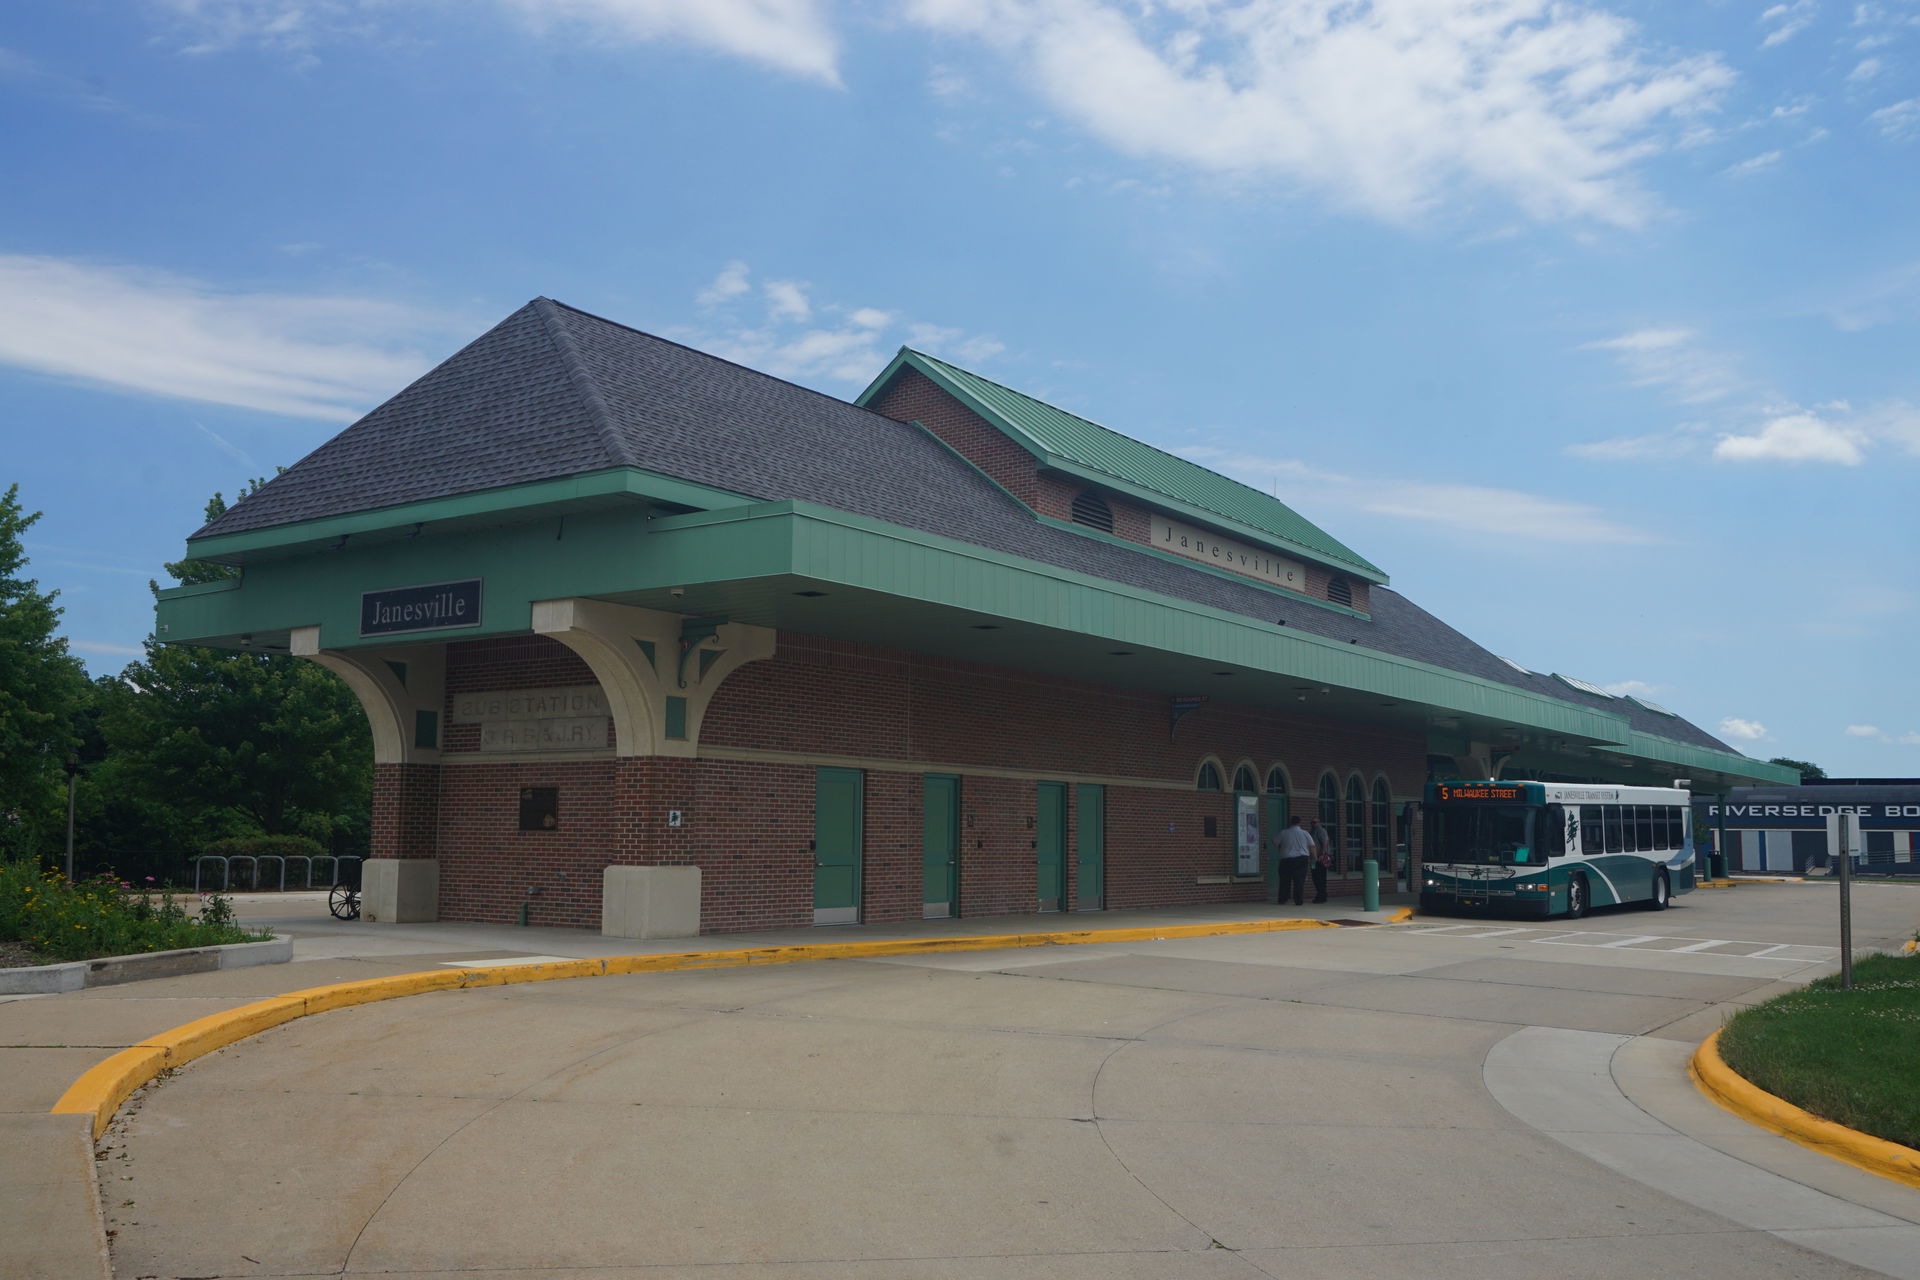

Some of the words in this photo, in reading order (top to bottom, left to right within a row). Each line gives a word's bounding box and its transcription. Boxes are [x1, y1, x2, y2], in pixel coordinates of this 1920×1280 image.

[1165, 527, 1293, 581] Janesville
[372, 593, 465, 625] Janesville
[1441, 787, 1449, 800] 5
[1453, 788, 1489, 799] MILWAUKEE
[1490, 789, 1517, 799] STREET
[1709, 805, 1871, 817] RIVERSEDGE
